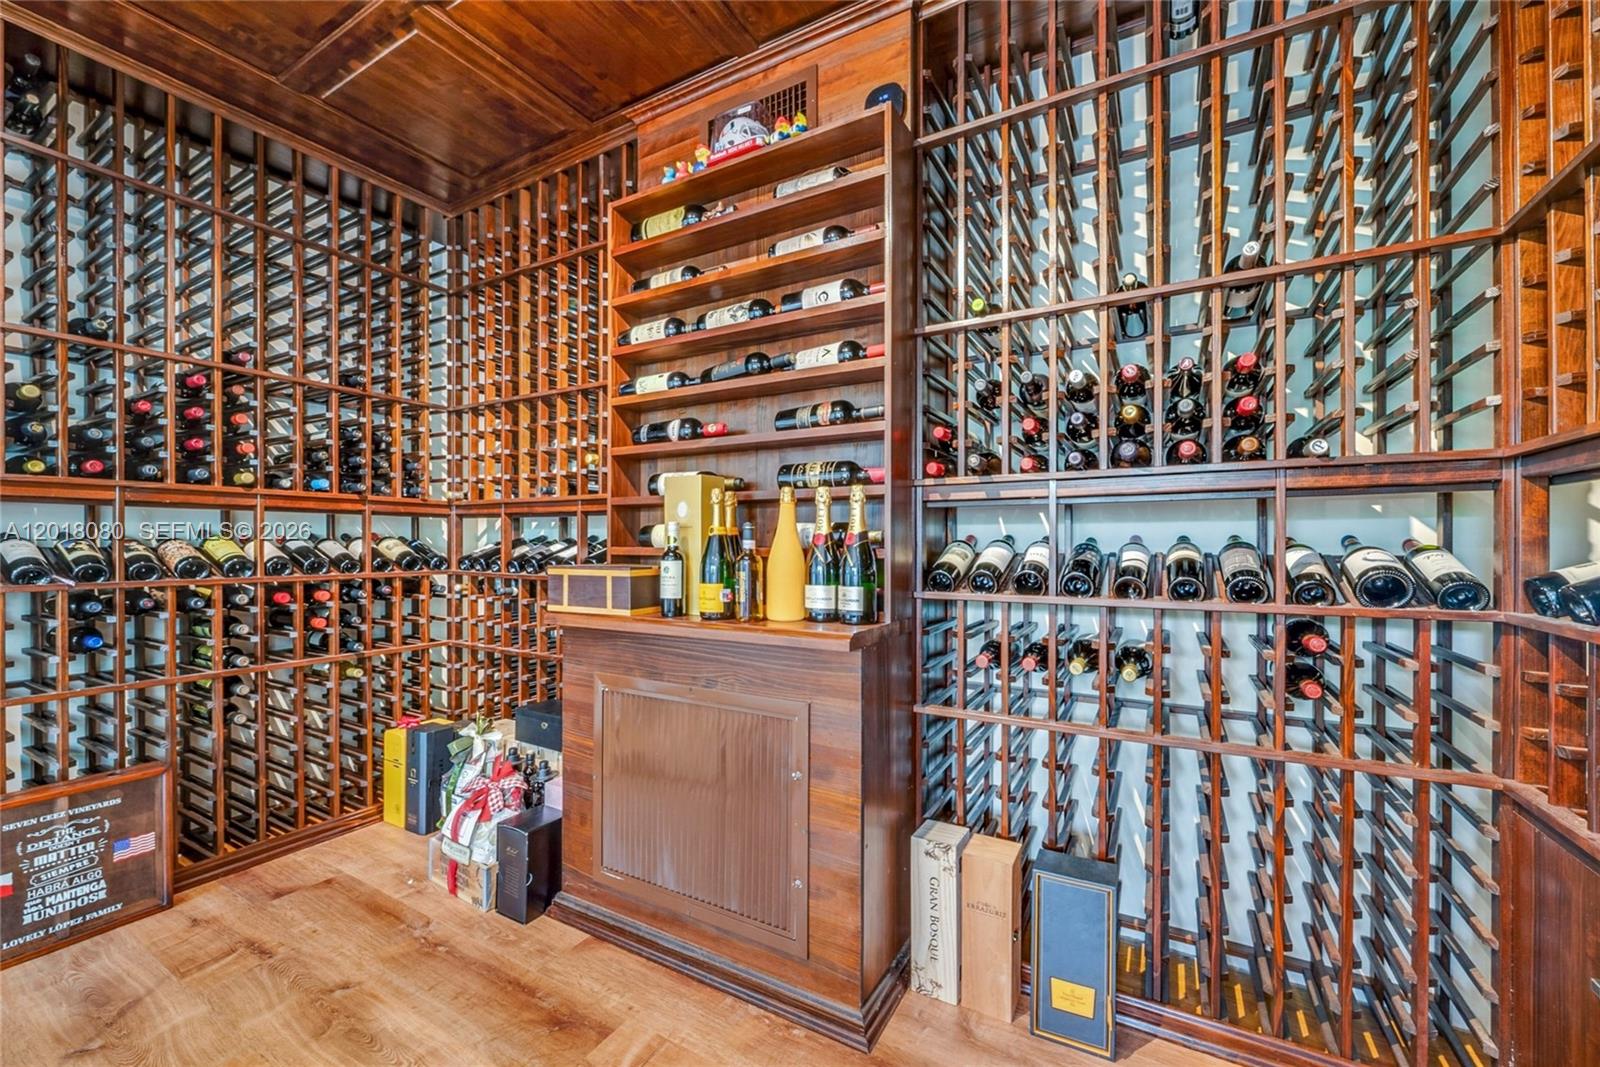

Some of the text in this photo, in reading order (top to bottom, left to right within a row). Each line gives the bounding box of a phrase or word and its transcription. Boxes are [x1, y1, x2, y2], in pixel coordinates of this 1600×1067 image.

[2, 817, 38, 832] SEVEN
[68, 798, 122, 816] VINEYARDS
[26, 826, 102, 853] DISTANCE
[54, 826, 76, 838] THE
[33, 841, 95, 867] MATTER
[40, 859, 90, 880] SIEMPRE
[72, 869, 103, 887] ALGO
[45, 879, 107, 907] MANTENGA
[929, 876, 941, 911] GRAN
[33, 893, 98, 922] UNIDOS
[2, 929, 47, 950] LOVELY
[85, 902, 124, 921] FAMILY
